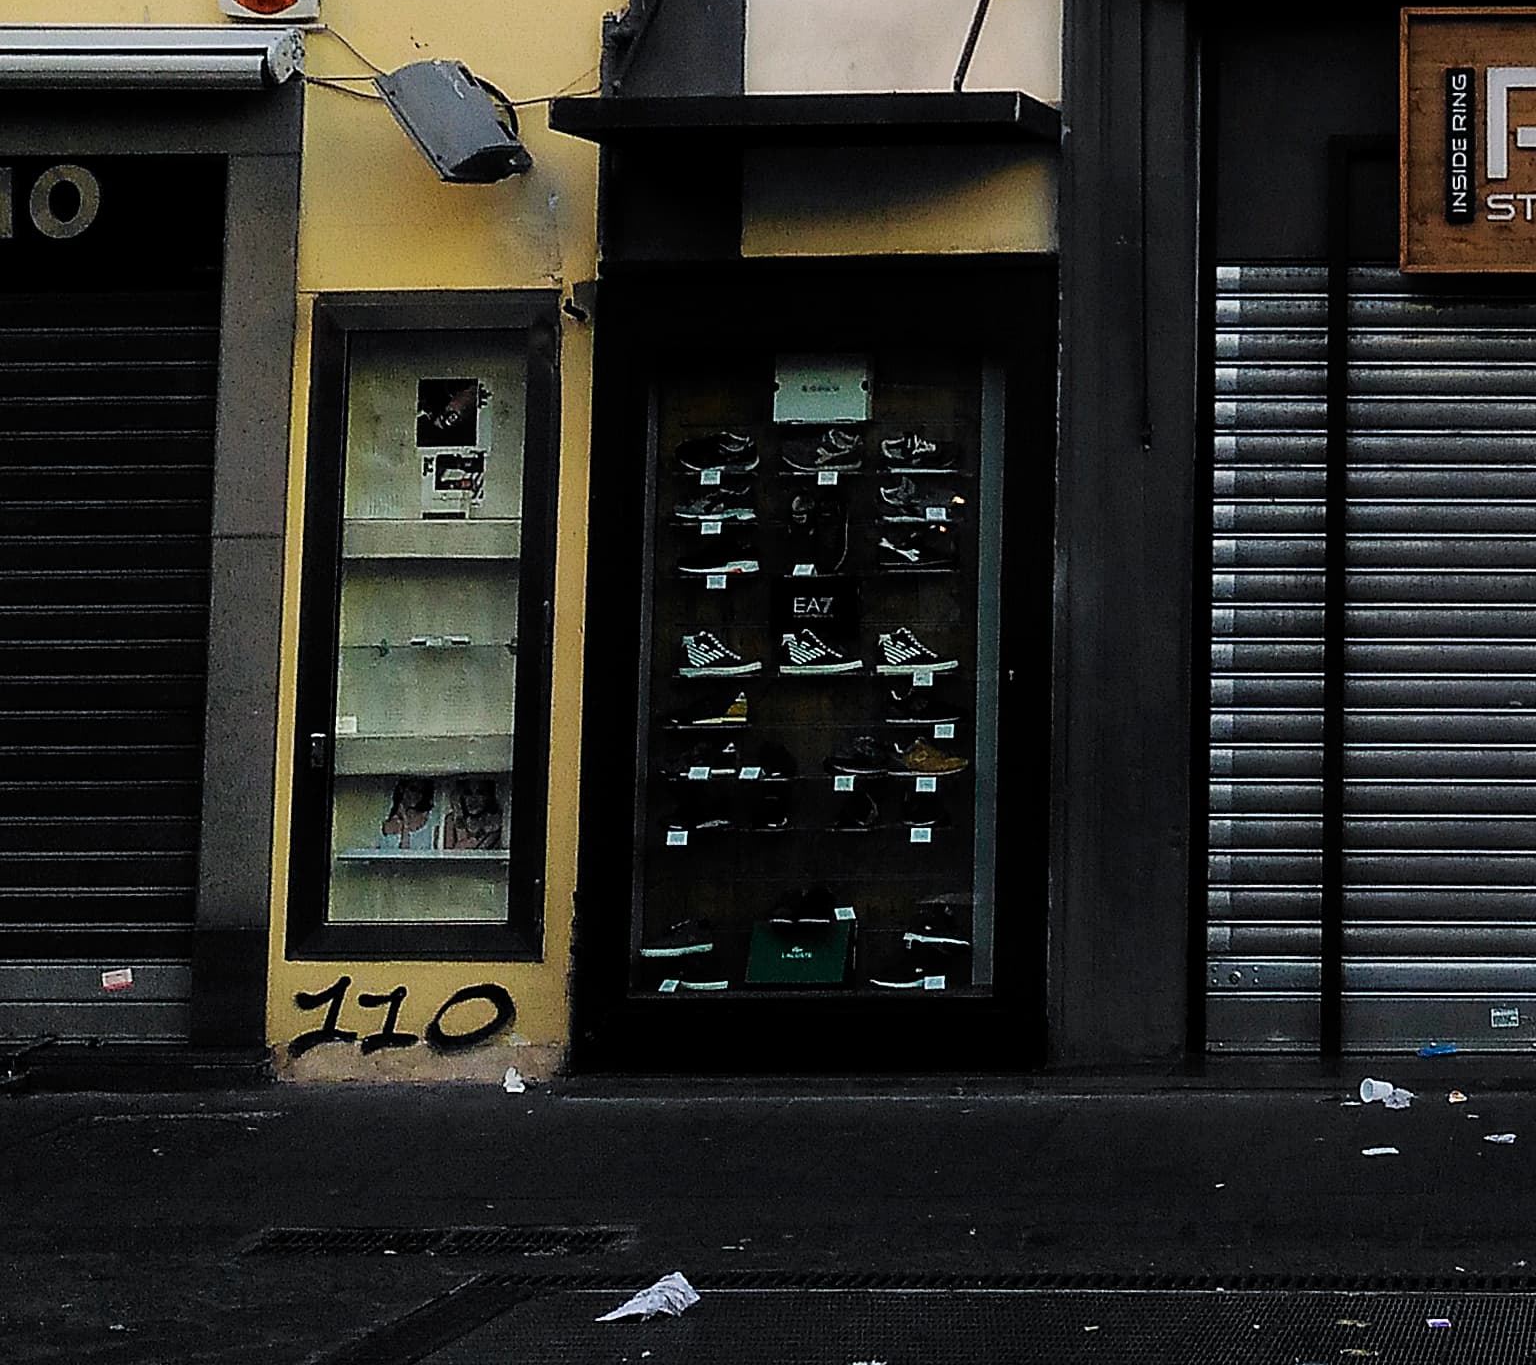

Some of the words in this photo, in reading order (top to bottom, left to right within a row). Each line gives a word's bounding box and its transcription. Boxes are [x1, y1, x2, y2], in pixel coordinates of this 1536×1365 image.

[1452, 73, 1467, 132] RING
[1452, 138, 1467, 213] INSIDE
[793, 596, 834, 614] EA7
[288, 975, 516, 1056] 110
